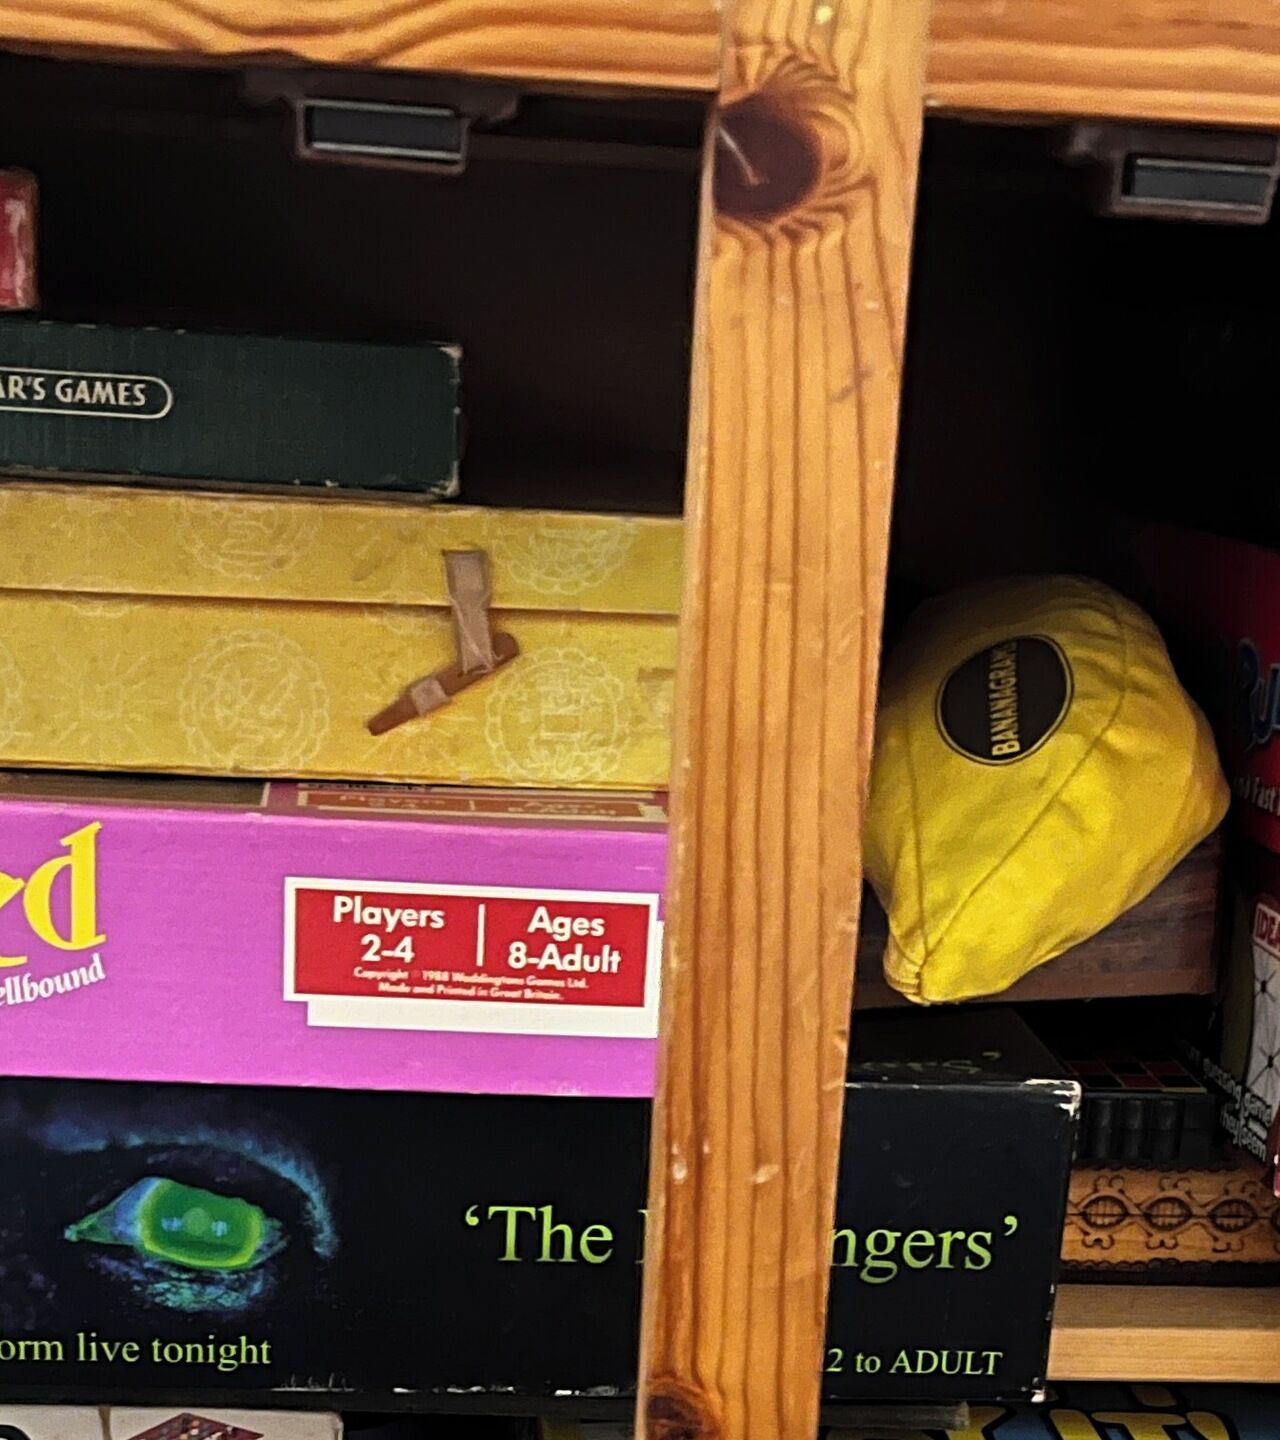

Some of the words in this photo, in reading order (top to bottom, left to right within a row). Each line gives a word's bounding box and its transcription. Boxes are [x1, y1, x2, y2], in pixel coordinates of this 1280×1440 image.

[55, 378, 146, 406] GAMES
[333, 896, 445, 932] Players
[528, 907, 604, 940] Ages
[361, 934, 415, 963] 2-4
[508, 942, 620, 973] 8-Adult
[76, 1331, 140, 1365] live
[151, 1335, 271, 1371] tonight
[889, 1350, 1002, 1378] ADULT
